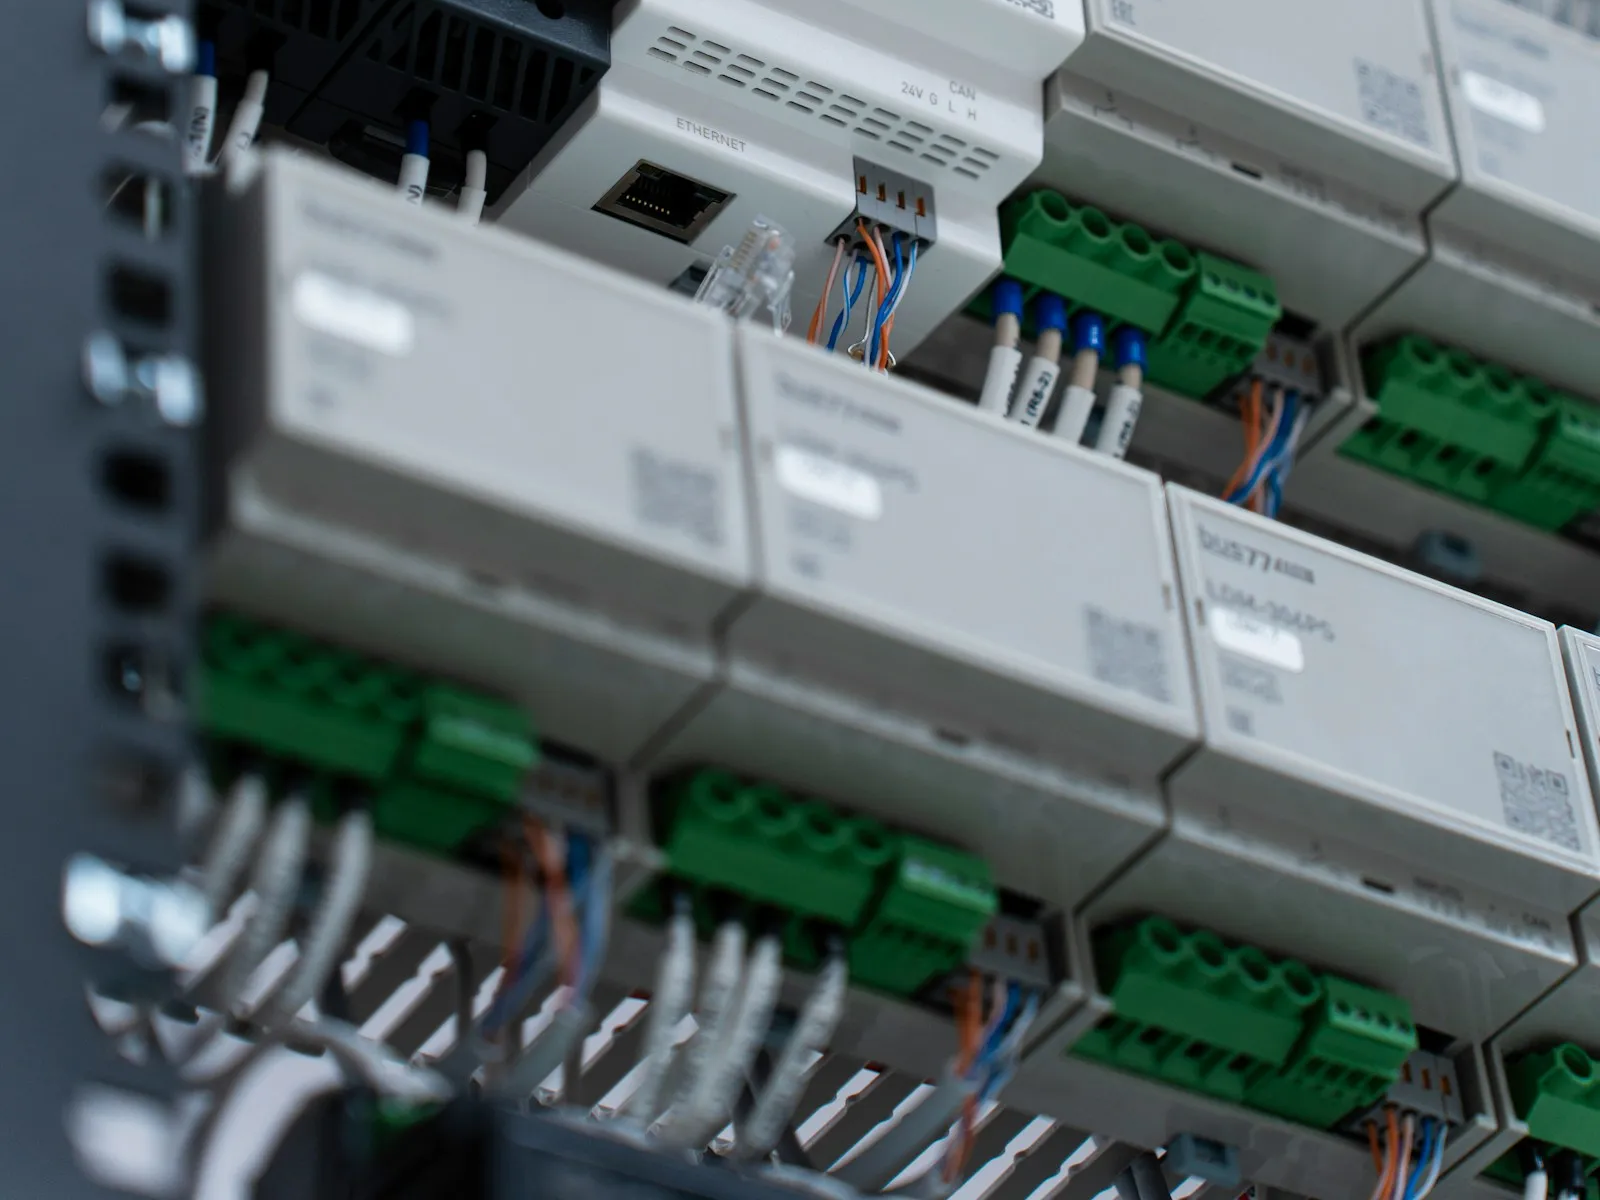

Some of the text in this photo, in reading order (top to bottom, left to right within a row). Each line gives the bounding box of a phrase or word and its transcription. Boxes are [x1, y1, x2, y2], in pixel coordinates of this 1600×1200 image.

[901, 81, 977, 121] 24V G L H
[949, 80, 976, 101] CAN
[676, 116, 748, 154] ETHERNET
